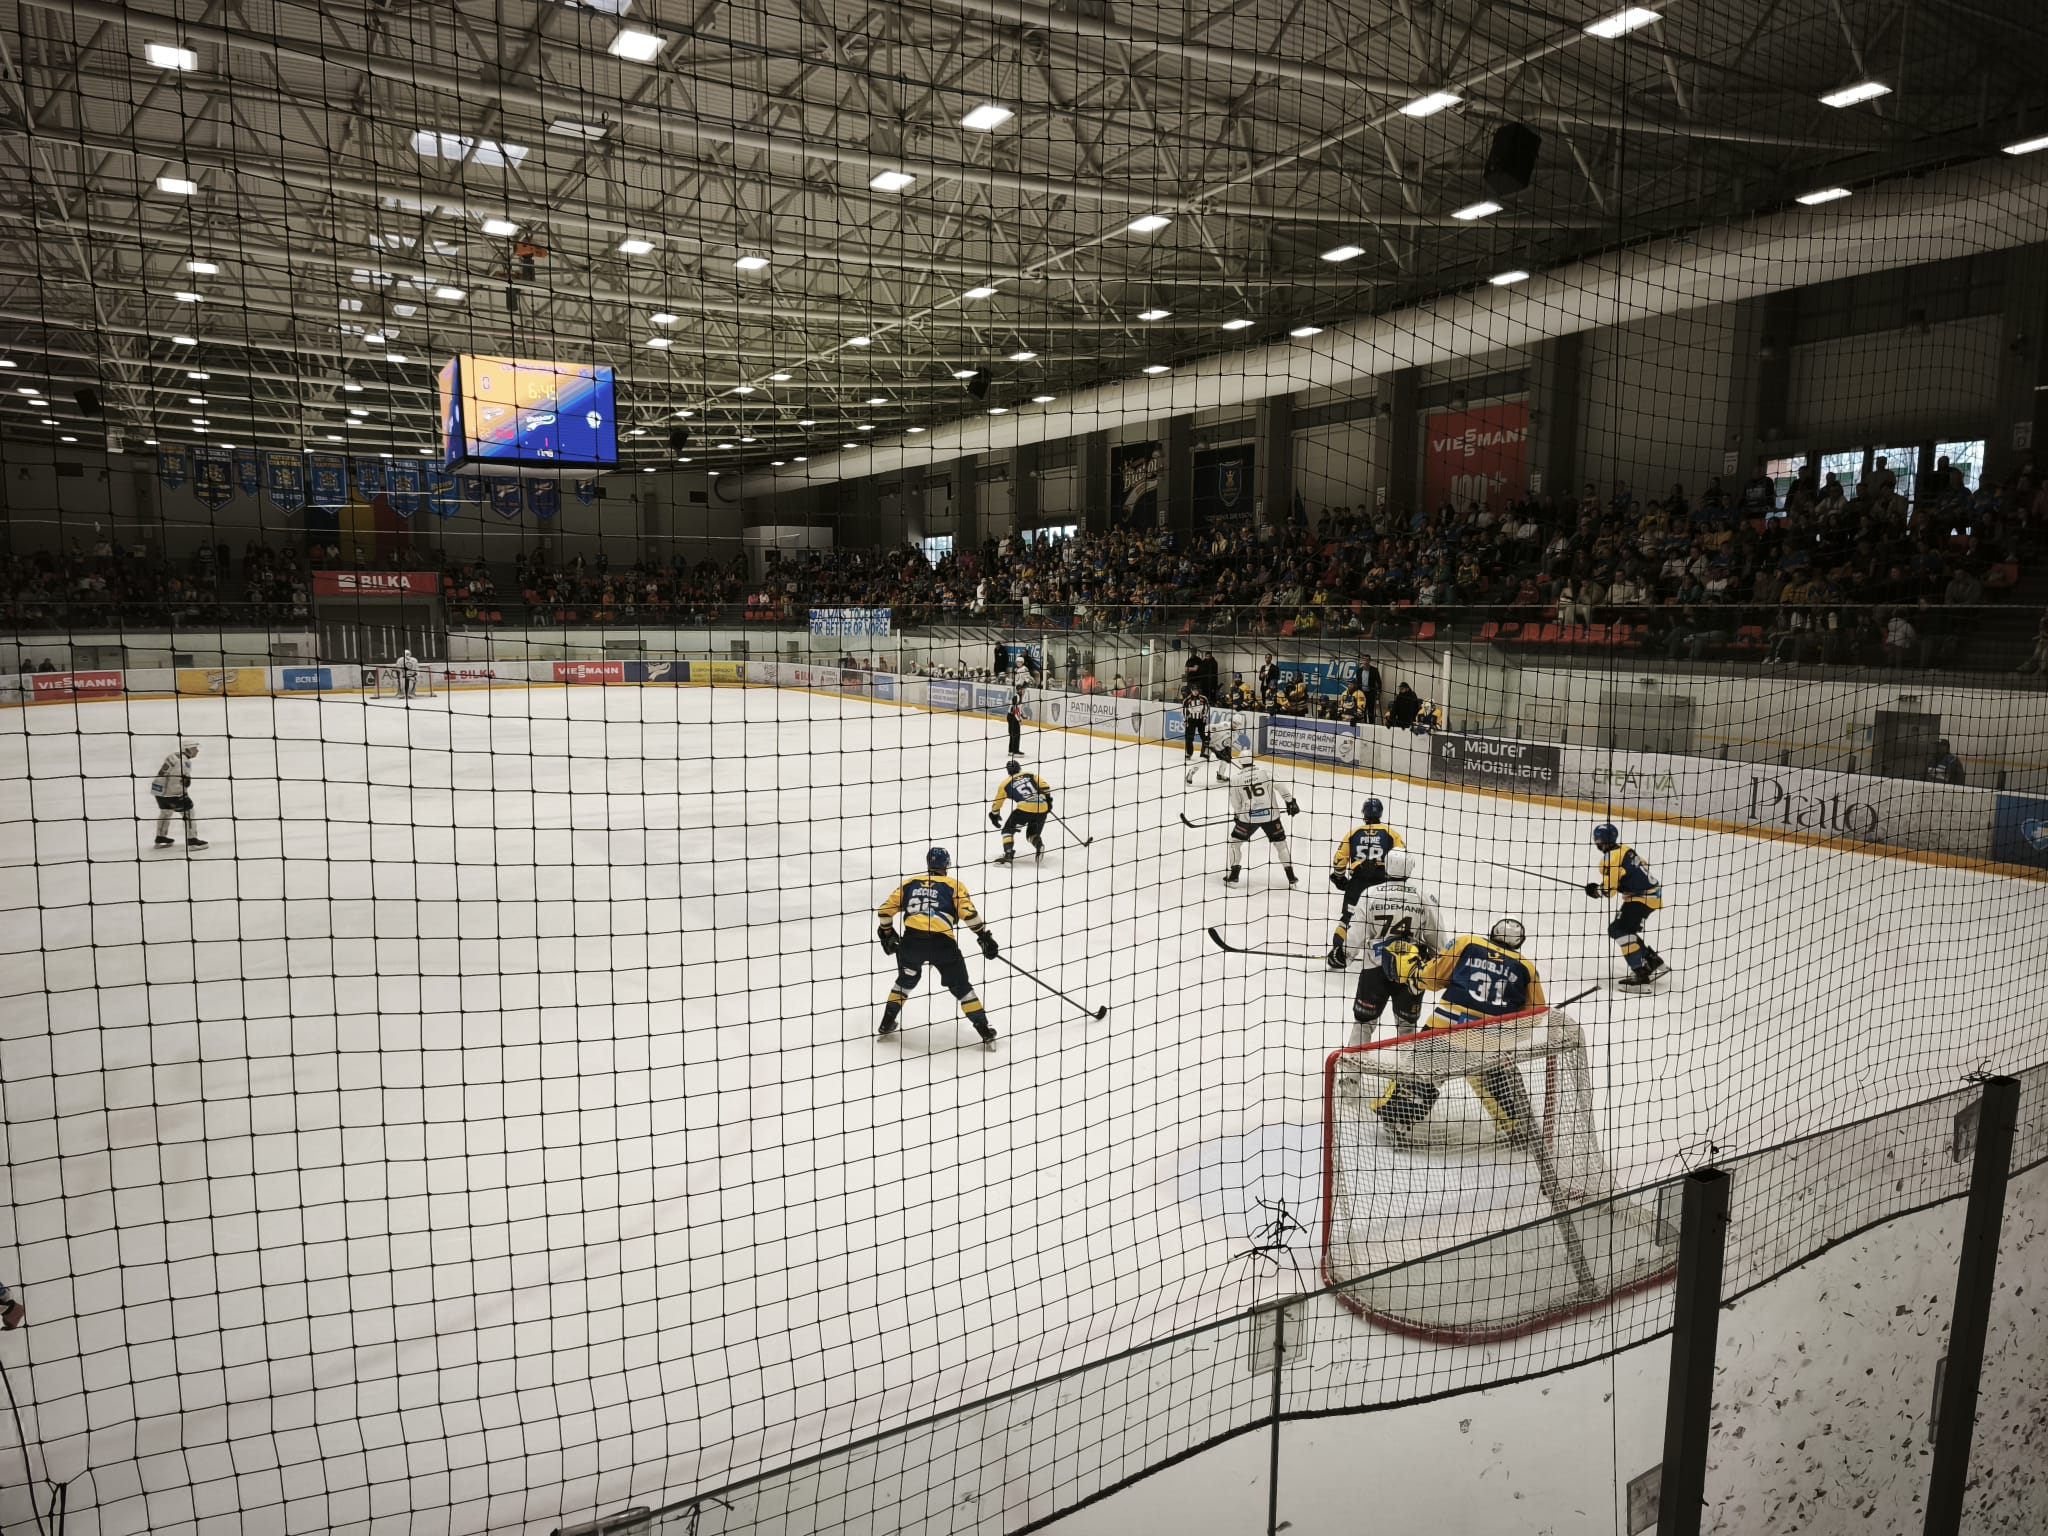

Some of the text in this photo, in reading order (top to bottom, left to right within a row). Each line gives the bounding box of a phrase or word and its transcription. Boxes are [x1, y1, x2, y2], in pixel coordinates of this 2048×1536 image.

[360, 575, 411, 588] BILKA
[810, 621, 823, 635] FOR
[460, 669, 497, 680] BILKA
[557, 664, 619, 679] VIESSMANN
[38, 677, 117, 693] VIESSMANN
[1243, 783, 1265, 800] 16
[1748, 776, 1878, 835] Prato
[1374, 914, 1414, 939] 74
[1468, 971, 1508, 1007] 31
